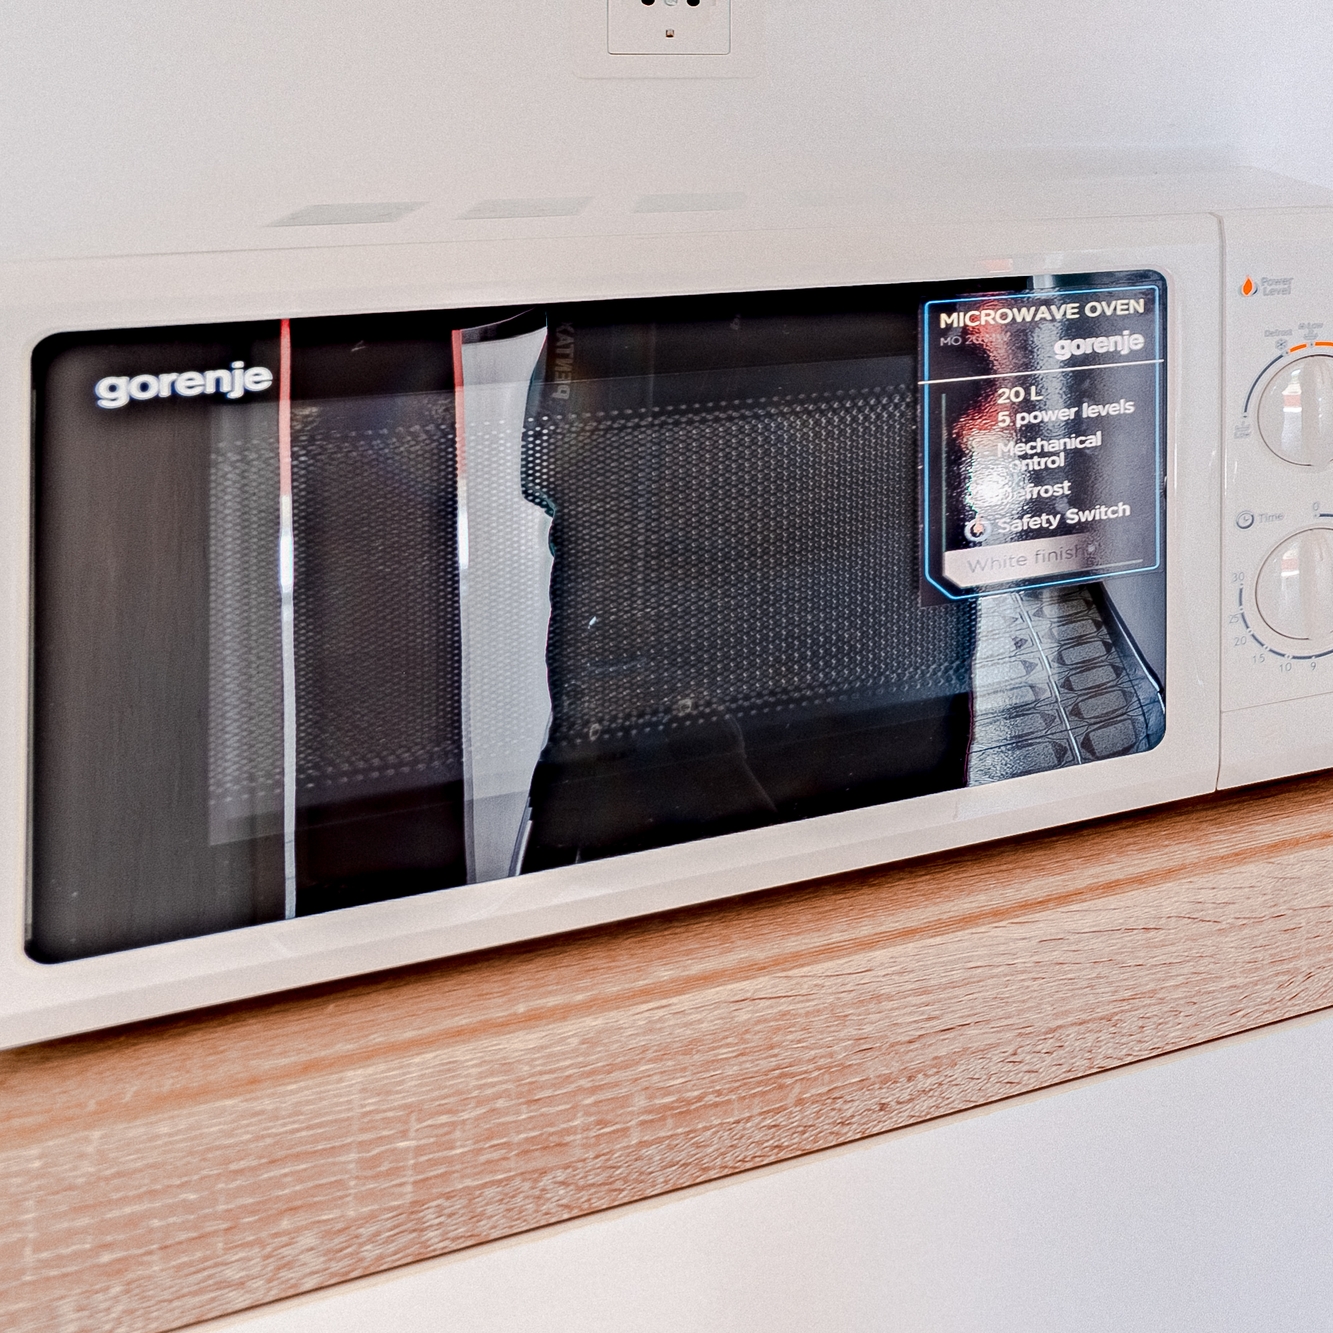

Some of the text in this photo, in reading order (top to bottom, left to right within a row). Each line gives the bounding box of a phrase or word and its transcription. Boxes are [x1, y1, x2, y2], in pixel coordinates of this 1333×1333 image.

[1260, 276, 1294, 287] Power
[1262, 285, 1292, 297] Level
[939, 298, 1146, 329] MICROWAVE OVEN
[1264, 328, 1293, 338] Defrost
[940, 335, 962, 347] MO
[1053, 330, 1146, 361] gorenje
[94, 360, 274, 410] gorenje
[996, 385, 1044, 405] 20 L
[996, 398, 1136, 428] 5 power levels
[996, 430, 1103, 458] Mechanical
[1003, 451, 1066, 474] ontrol
[1311, 501, 1320, 512] 0
[997, 501, 1132, 535] Safety Switch
[1258, 512, 1285, 521] Time
[966, 545, 1086, 574] White finish
[1231, 571, 1246, 583] 30
[1228, 614, 1240, 625] 25
[1234, 636, 1247, 646] 20
[1252, 653, 1266, 664] 15
[1279, 662, 1293, 672] 10
[1309, 661, 1317, 671] 9
